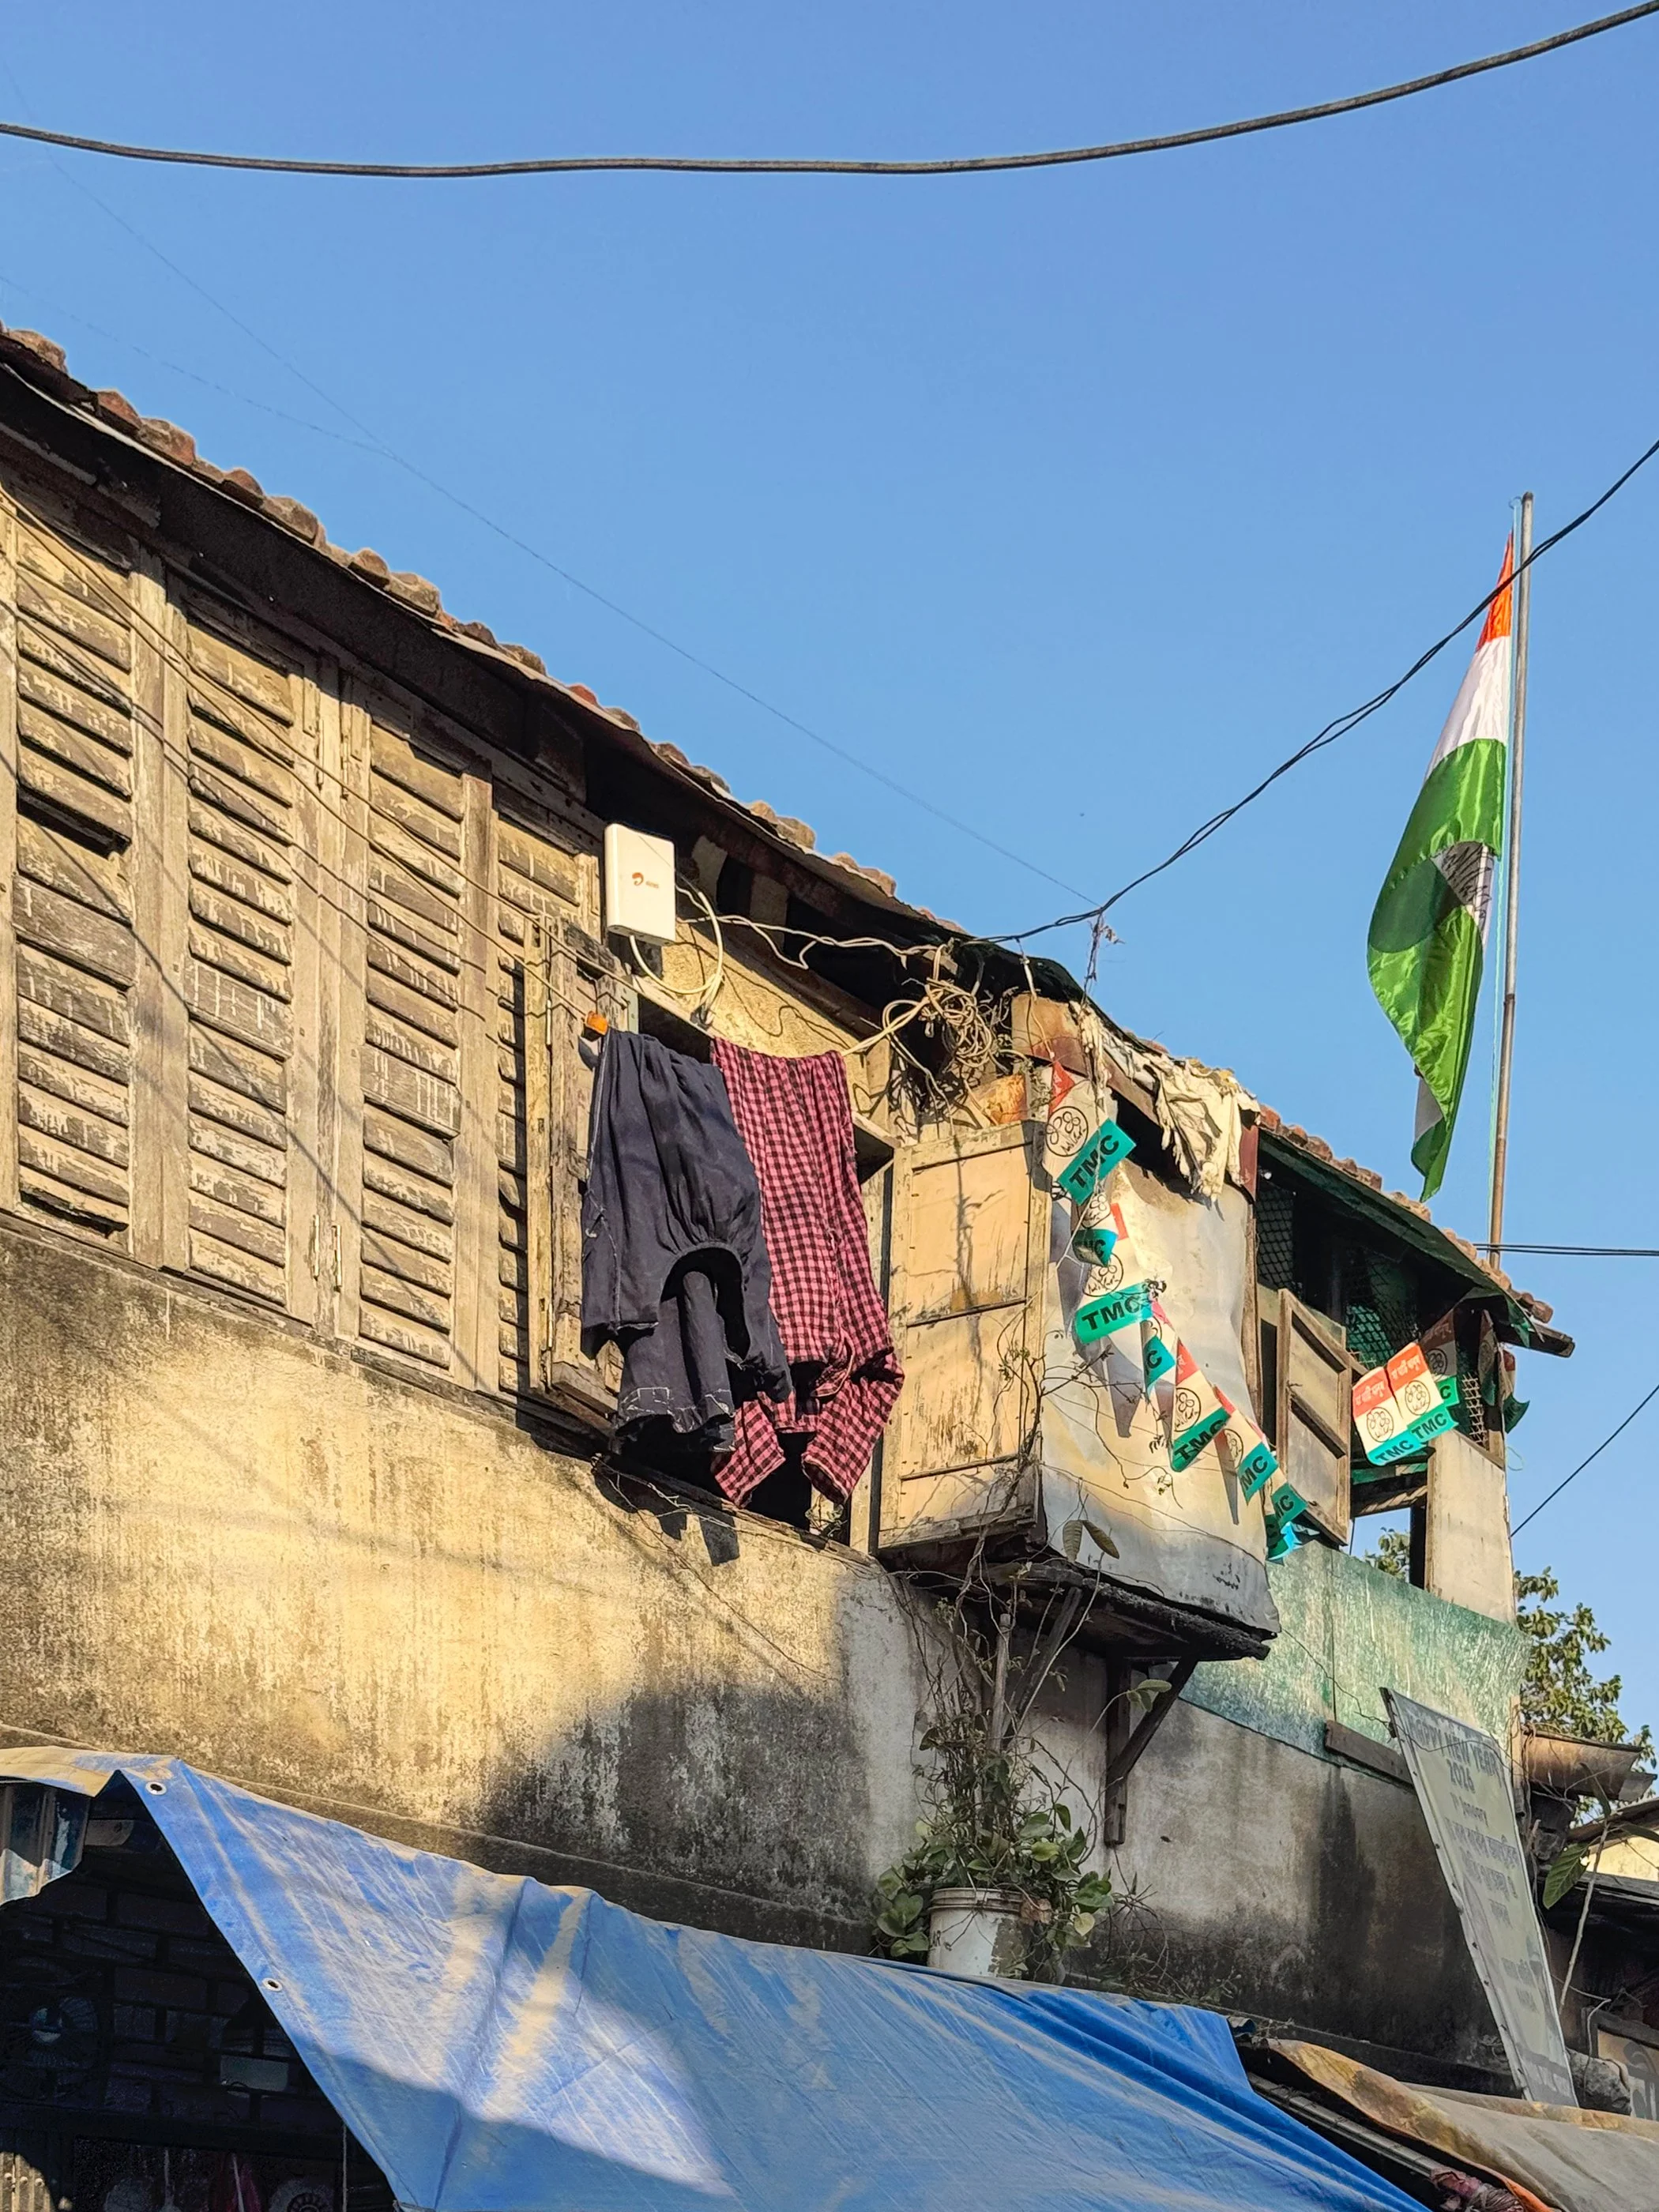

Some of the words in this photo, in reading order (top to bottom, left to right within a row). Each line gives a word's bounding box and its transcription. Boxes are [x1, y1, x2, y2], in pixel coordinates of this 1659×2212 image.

[1069, 1134, 1119, 1188] TMC
[1082, 1296, 1141, 1330] TMC
[1174, 1420, 1224, 1461] TMC
[1412, 1413, 1447, 1439] TMC
[1375, 1439, 1414, 1462] TMC
[1240, 1456, 1268, 1491] MC
[1407, 1710, 1445, 1757] HAPPY
[1444, 1732, 1471, 1766] NEW
[1470, 1743, 1501, 1787] YEAR
[1446, 1759, 1476, 1794] 2026
